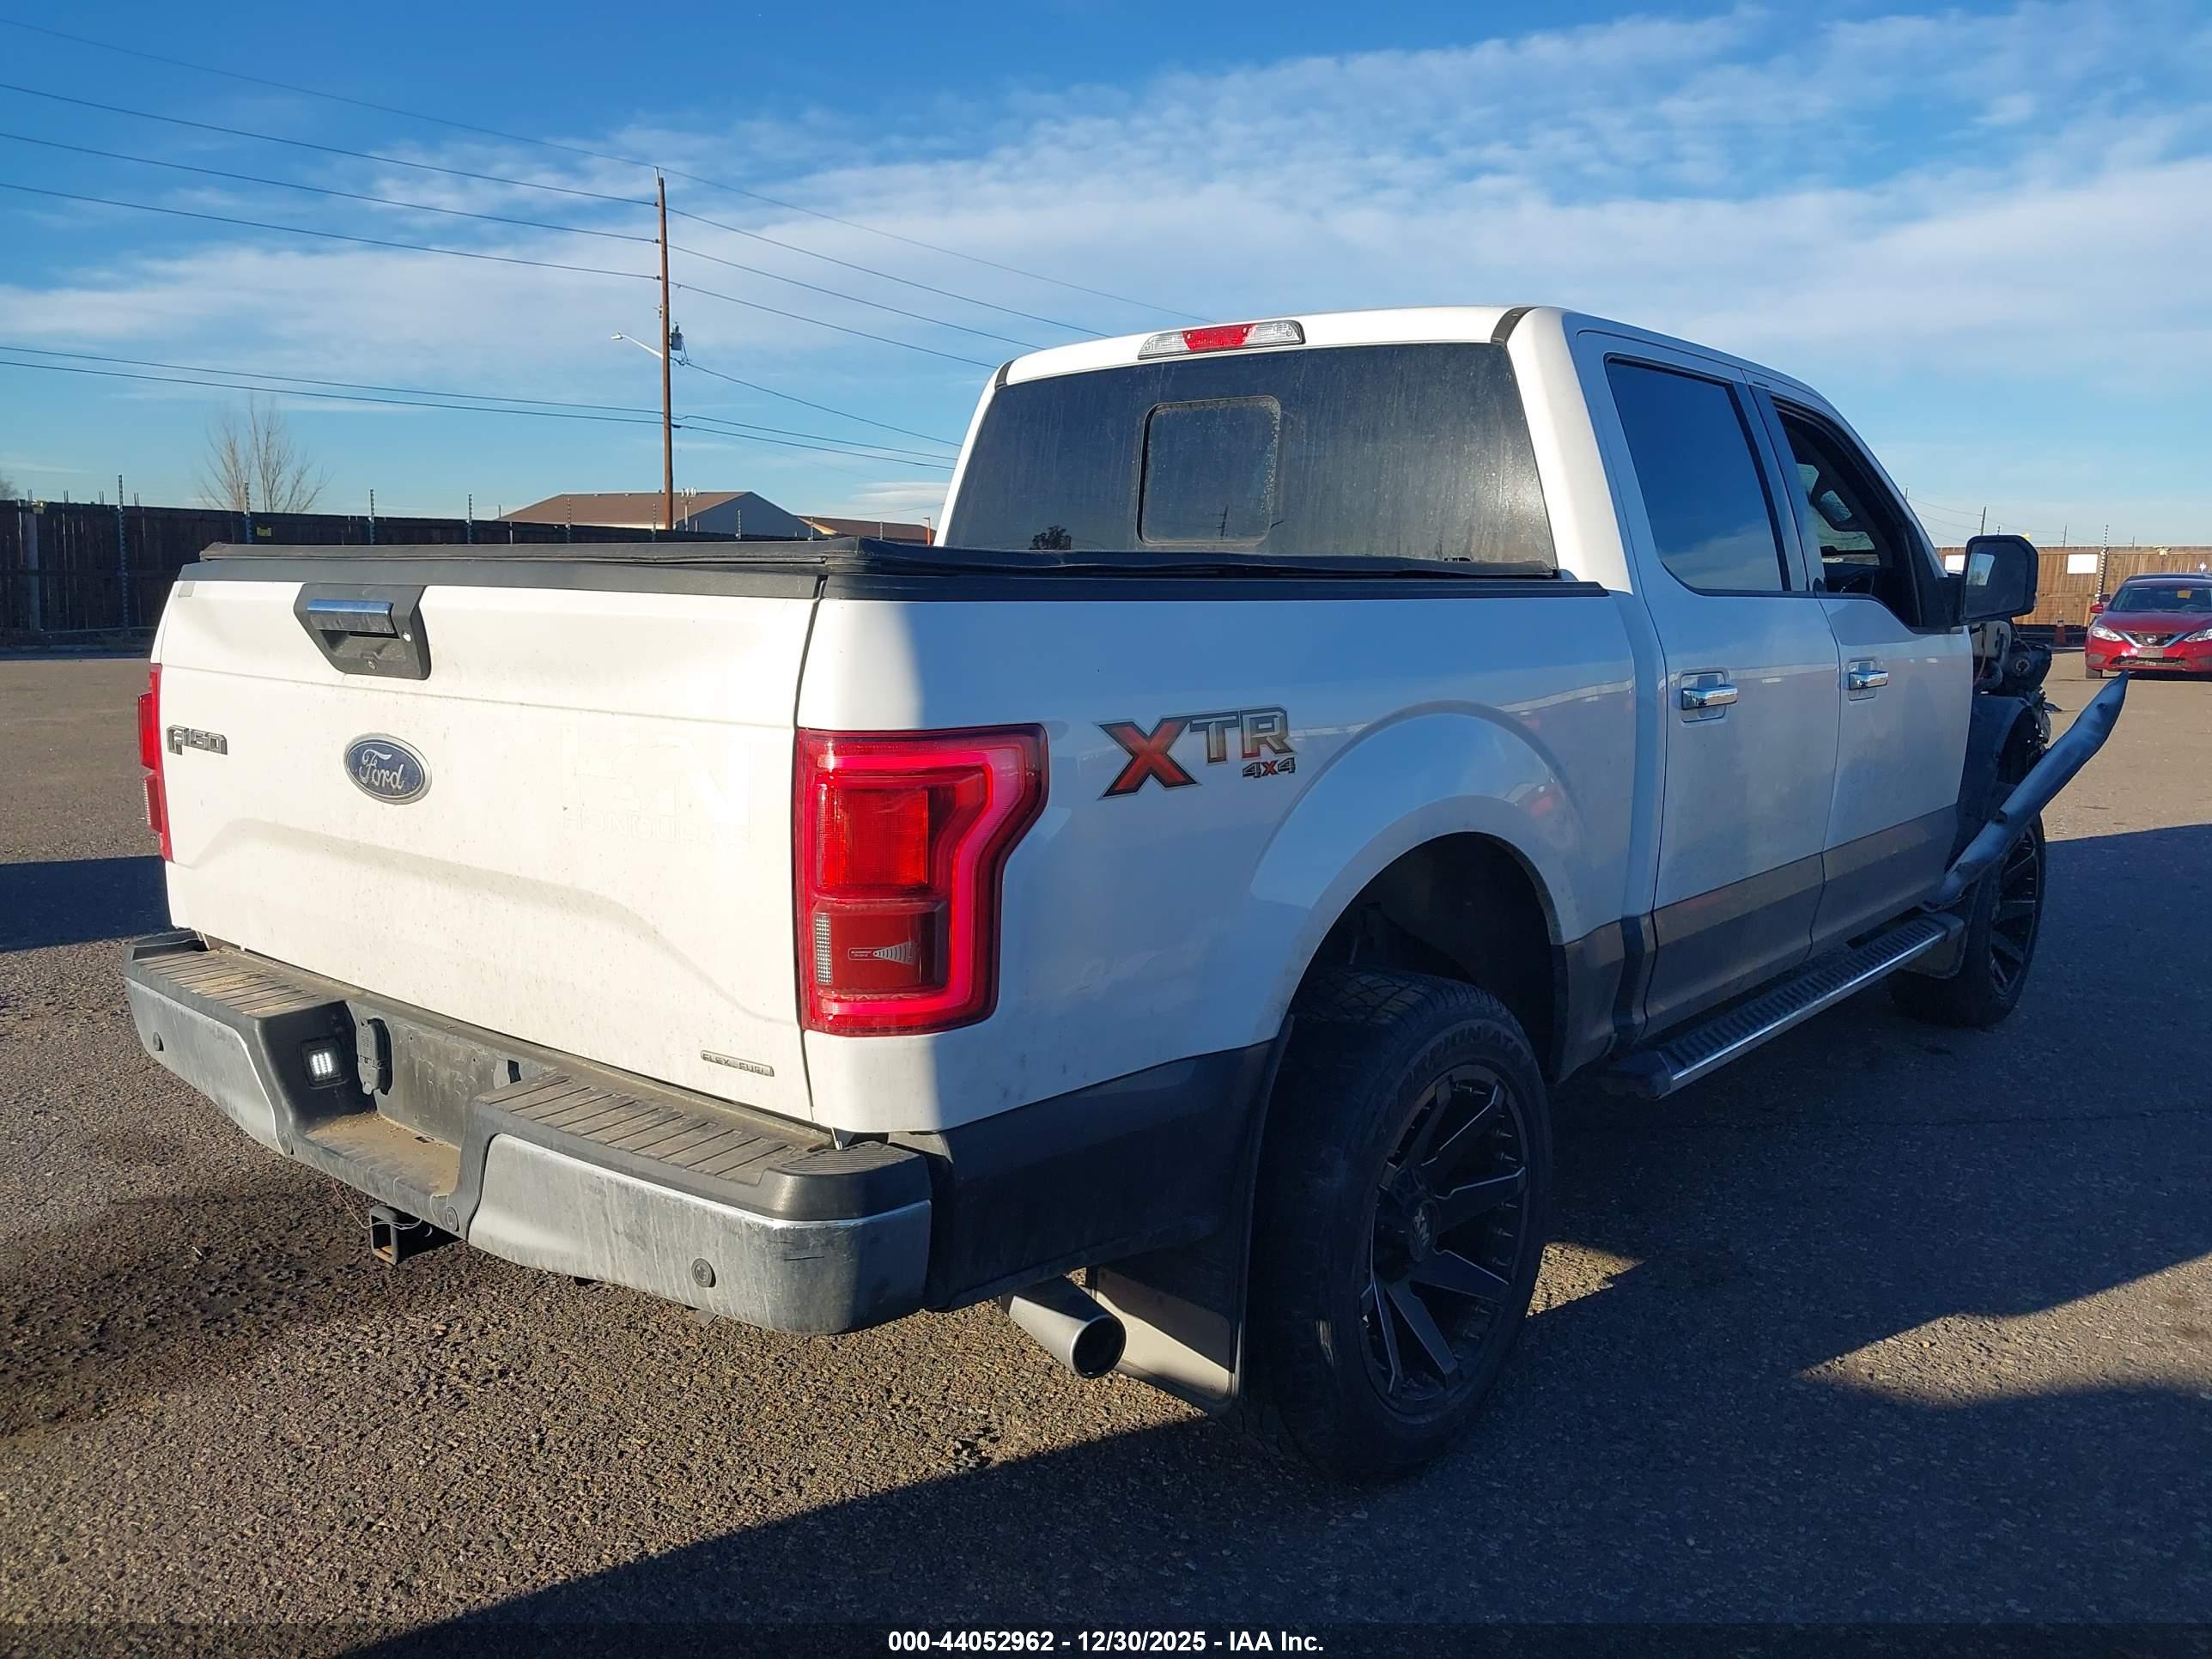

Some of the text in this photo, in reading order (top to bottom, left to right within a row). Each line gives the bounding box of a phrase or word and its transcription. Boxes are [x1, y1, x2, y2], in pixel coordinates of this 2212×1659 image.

[359, 749, 407, 790] Ford
[1095, 705, 1295, 799] XTR
[702, 1053, 770, 1076] FLEX FUEL
